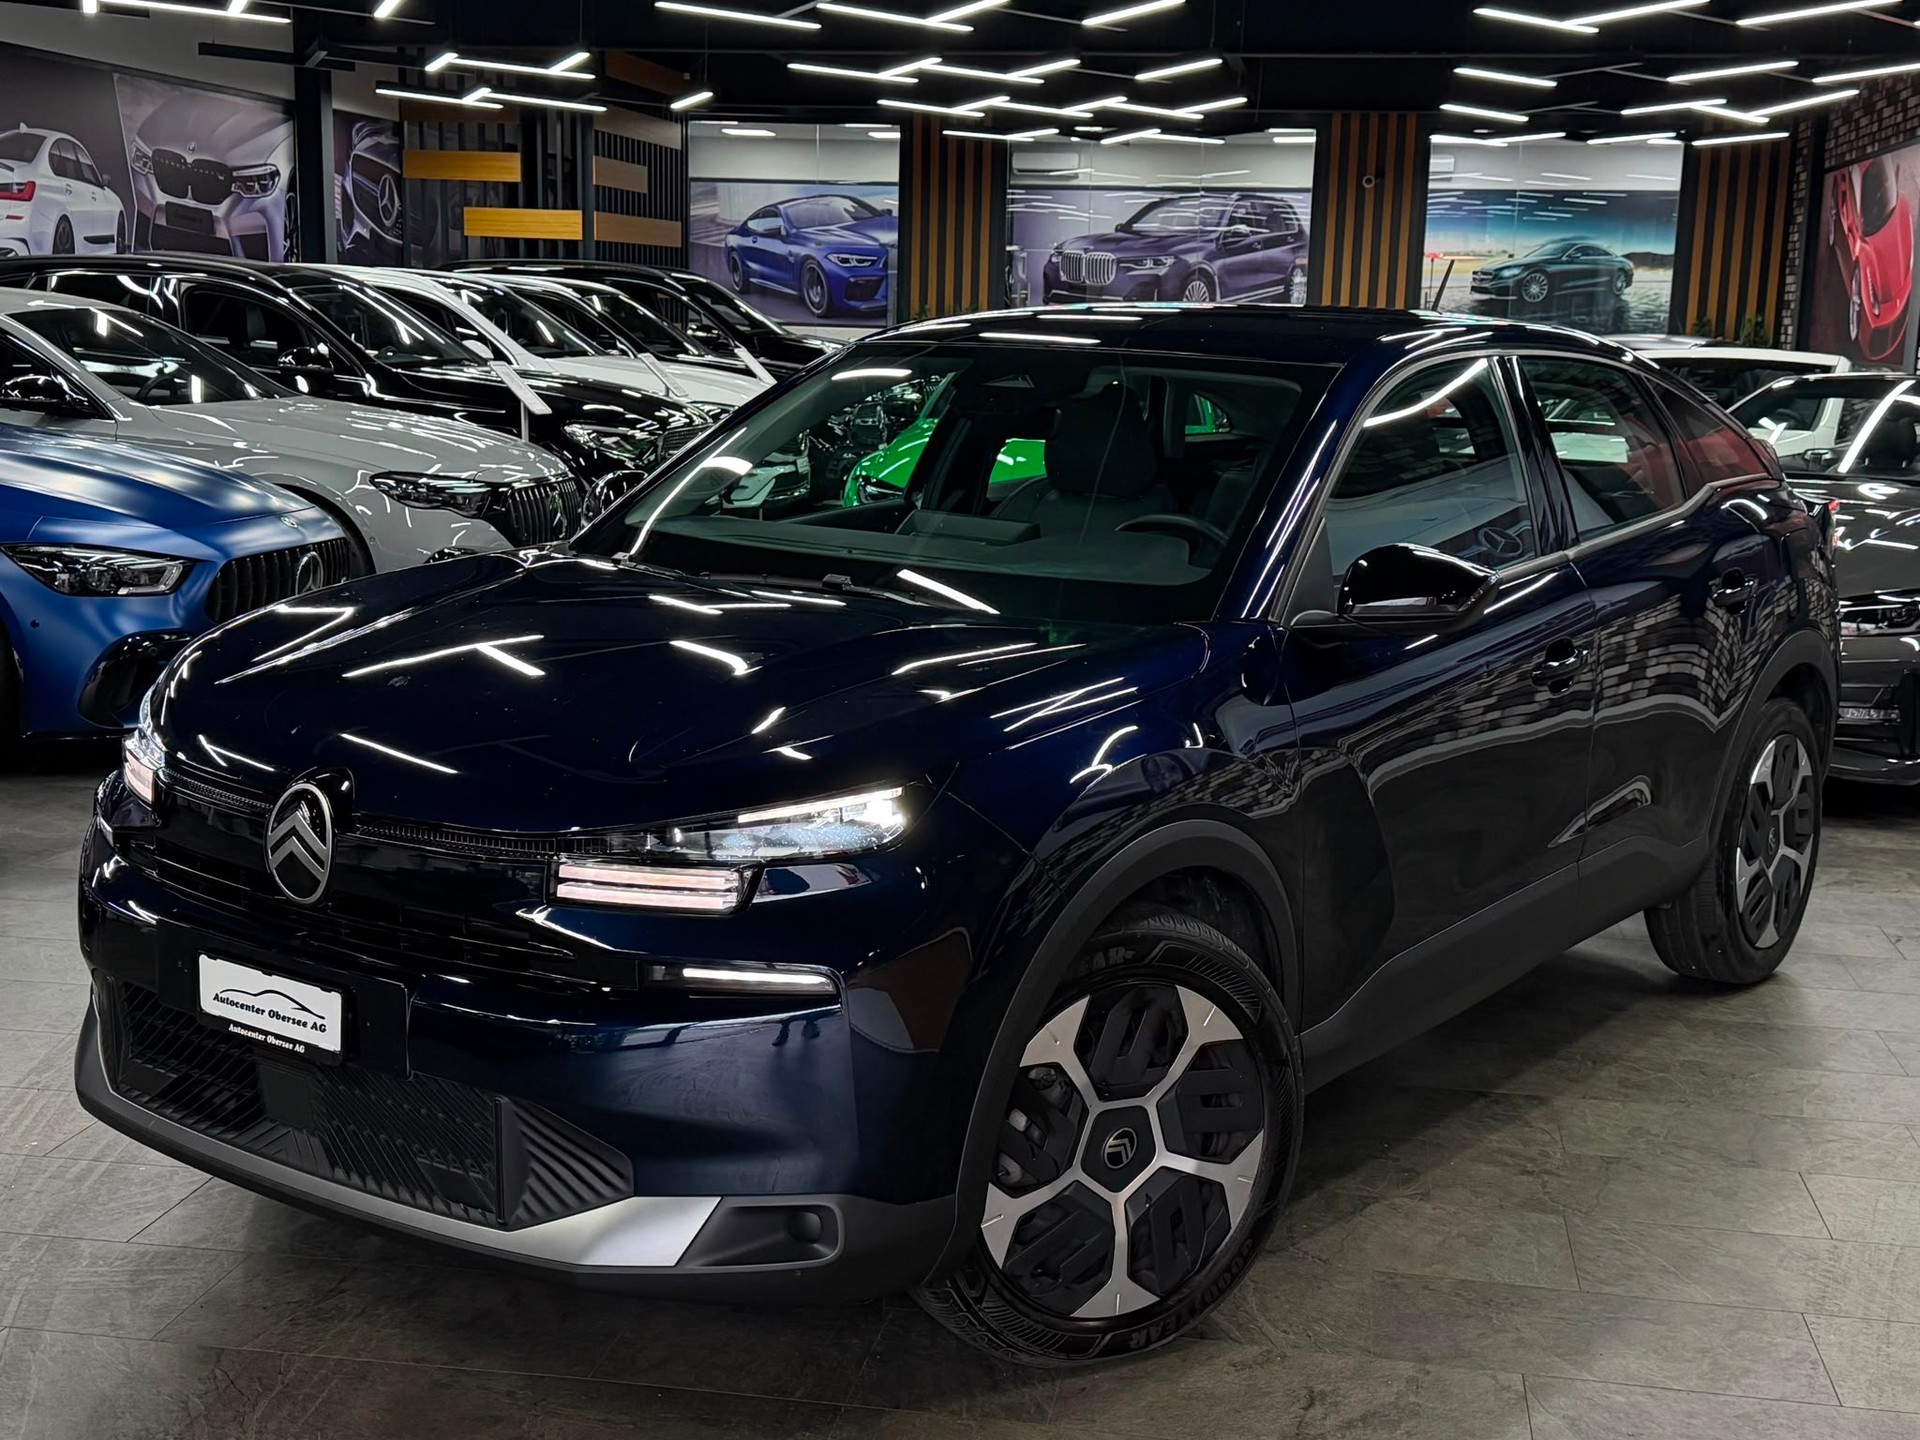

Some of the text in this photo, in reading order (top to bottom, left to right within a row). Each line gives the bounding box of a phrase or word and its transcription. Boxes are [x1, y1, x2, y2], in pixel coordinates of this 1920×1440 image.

[213, 993, 327, 1033] Autocenter Obersee AG
[228, 1023, 305, 1053] Autocenter Obersee AG
